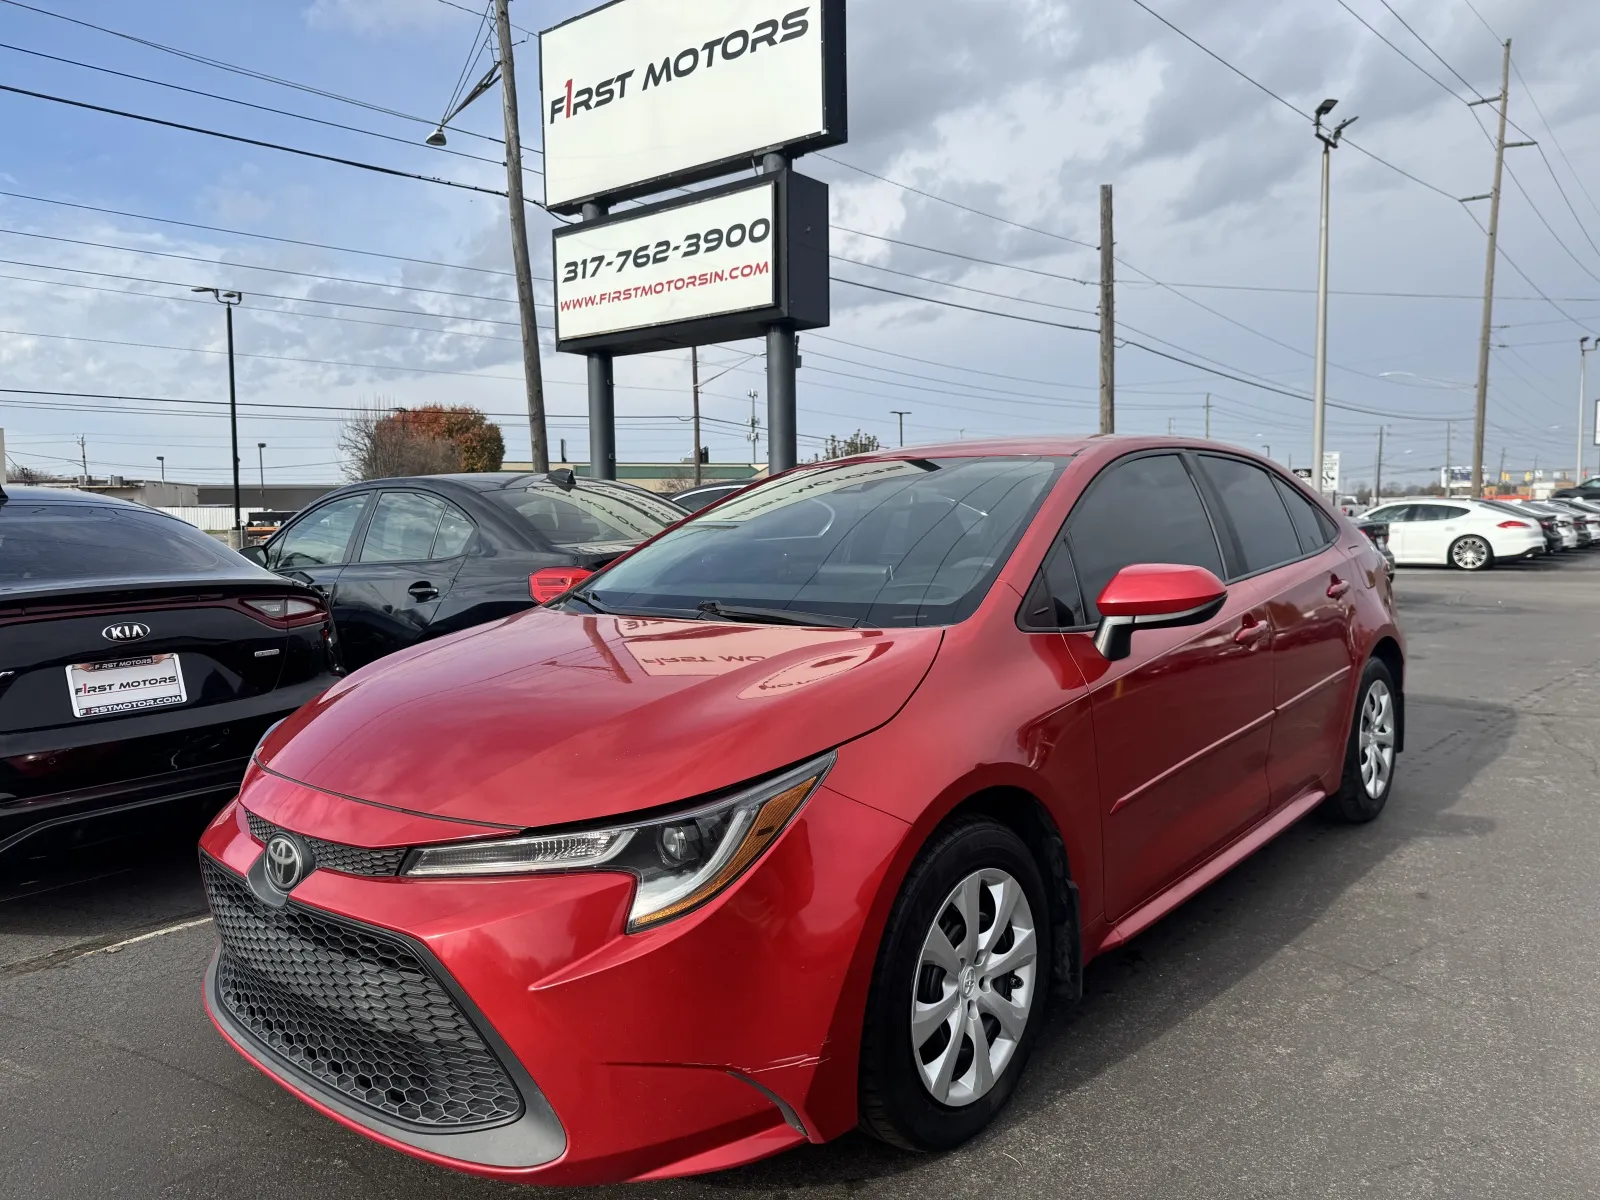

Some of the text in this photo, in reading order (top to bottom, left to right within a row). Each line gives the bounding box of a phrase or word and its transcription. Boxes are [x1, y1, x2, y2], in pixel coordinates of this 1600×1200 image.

[642, 6, 810, 91] MOTORS
[562, 218, 770, 283] 317-762-3900
[560, 261, 769, 312] WWW.FIRSTMOTORSIN.COM
[110, 624, 144, 640] KIA
[119, 658, 152, 667] MOTORS
[118, 676, 177, 690] MOTORS
